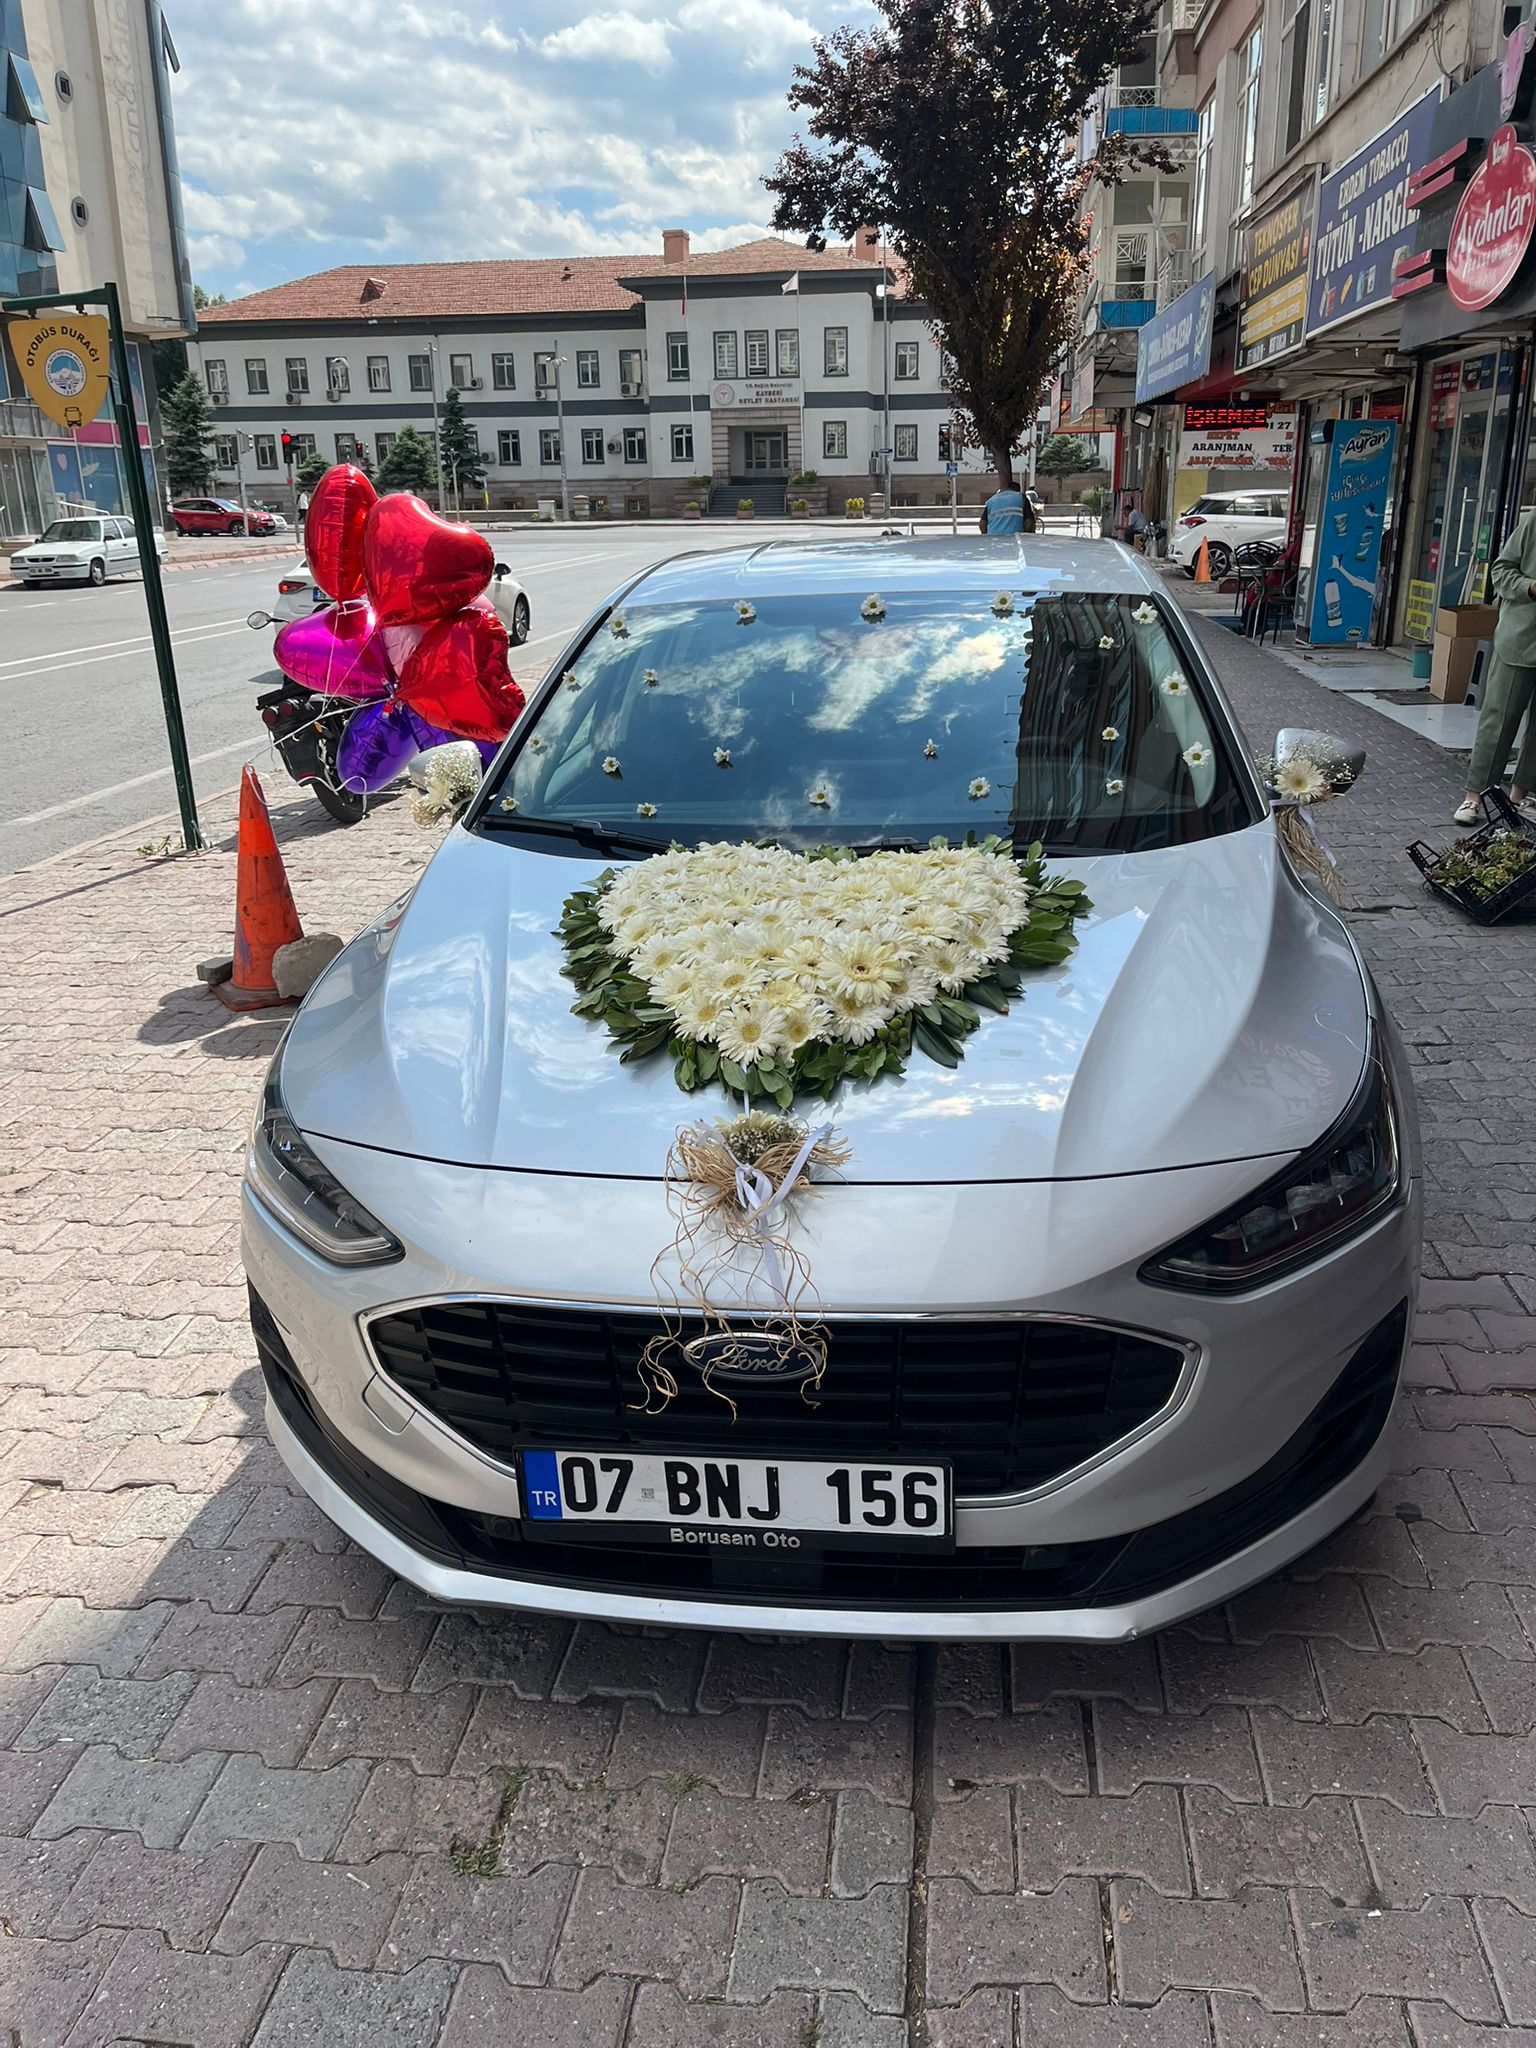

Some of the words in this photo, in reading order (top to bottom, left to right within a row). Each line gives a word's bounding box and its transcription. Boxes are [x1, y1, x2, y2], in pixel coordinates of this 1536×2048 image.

[1338, 159, 1367, 210] ERDEM
[1368, 129, 1409, 188] TOBACCO
[1315, 210, 1358, 280] TÜTÜN
[1454, 187, 1532, 279] Aydınlar
[1249, 268, 1263, 298] CEP
[26, 326, 57, 367] OTOBÜS
[61, 326, 100, 362] DURAĞI
[1277, 421, 1292, 430] 27
[1192, 443, 1253, 453] ARANJMAN
[1345, 432, 1386, 455] Ayran
[716, 1343, 788, 1372] Ford
[531, 1490, 557, 1506] TR
[561, 1456, 634, 1513] 07
[664, 1461, 780, 1521] BNJ
[826, 1469, 938, 1528] 156
[670, 1528, 756, 1547] Borusan
[763, 1531, 800, 1549] Oto
